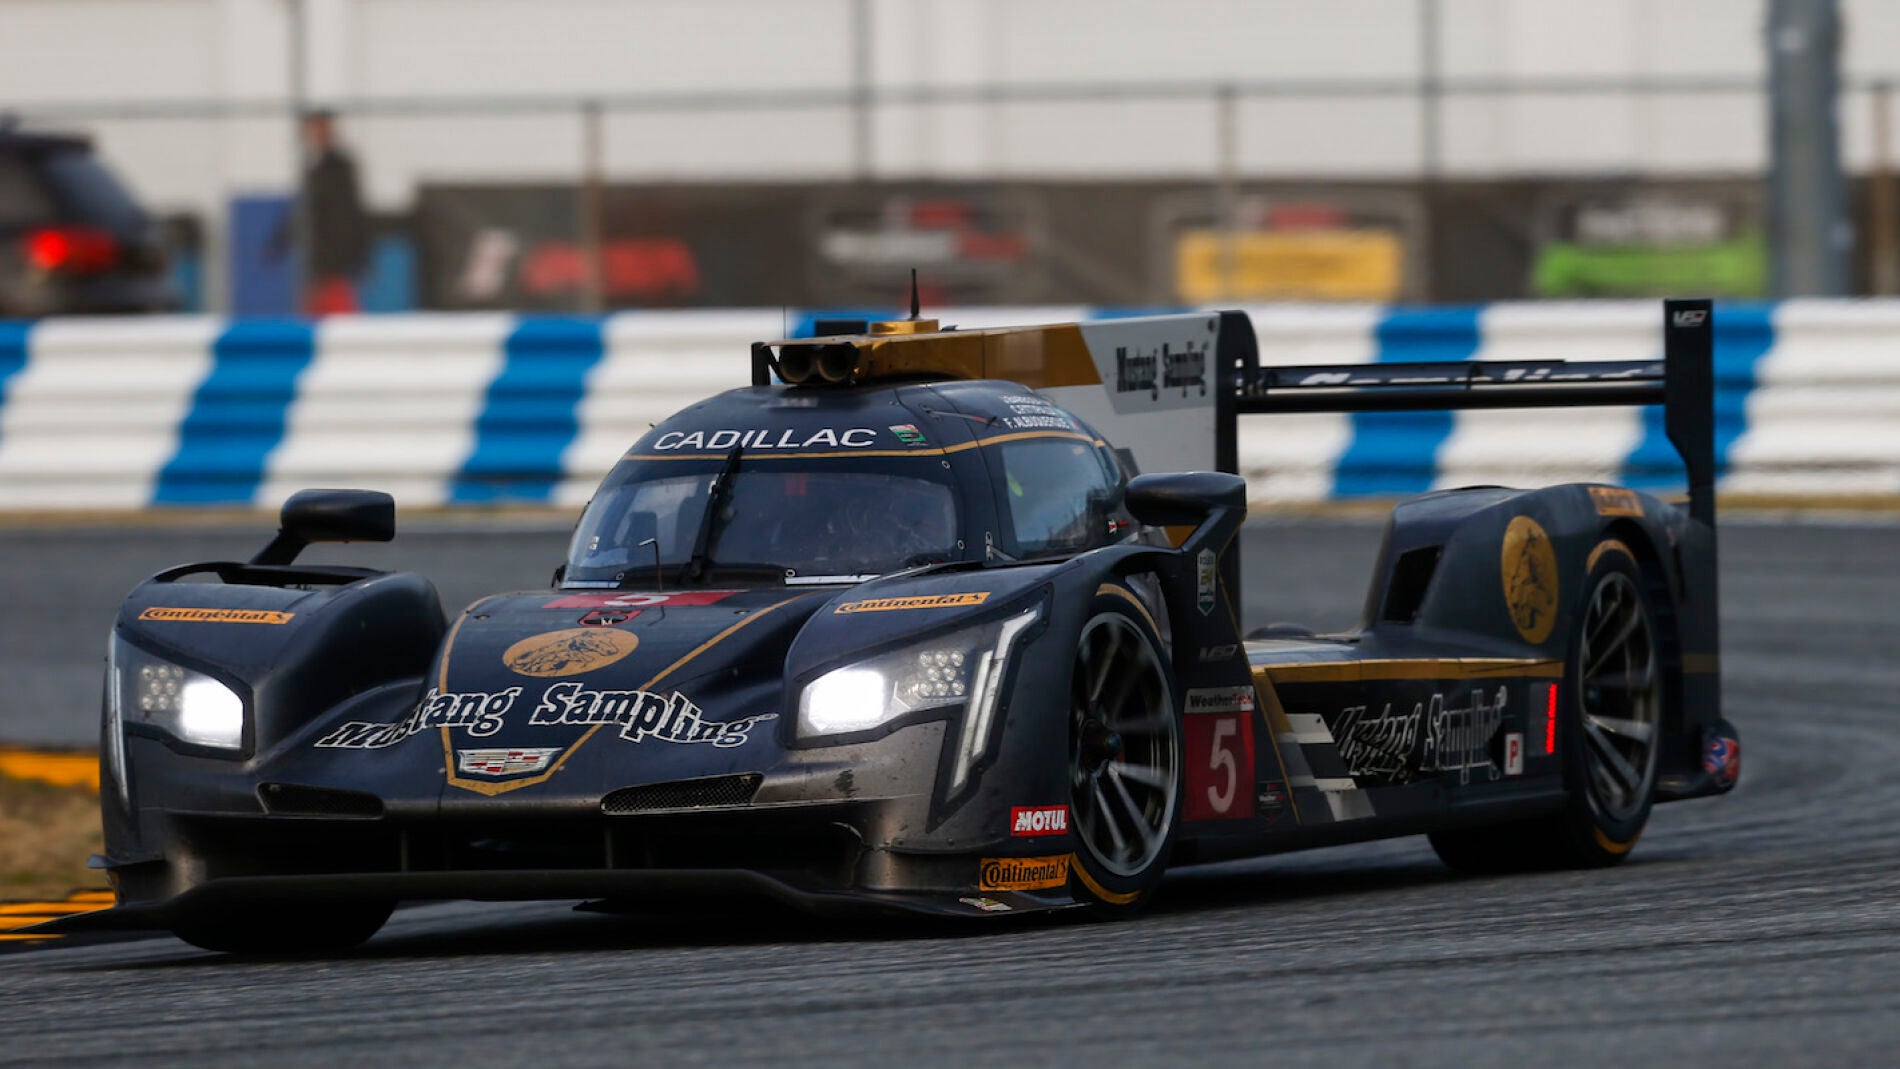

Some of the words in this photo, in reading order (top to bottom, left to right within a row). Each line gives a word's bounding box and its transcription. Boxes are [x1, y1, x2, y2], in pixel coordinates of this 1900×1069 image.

[653, 428, 877, 450] CADILLAC
[144, 608, 268, 622] Continental
[838, 595, 964, 612] Continental
[314, 687, 522, 748] Mustang
[528, 683, 779, 748] Sampling
[1207, 718, 1237, 813] 5
[1509, 740, 1518, 768] P
[1014, 809, 1066, 831] MOTUL
[981, 861, 1059, 888] Continental
